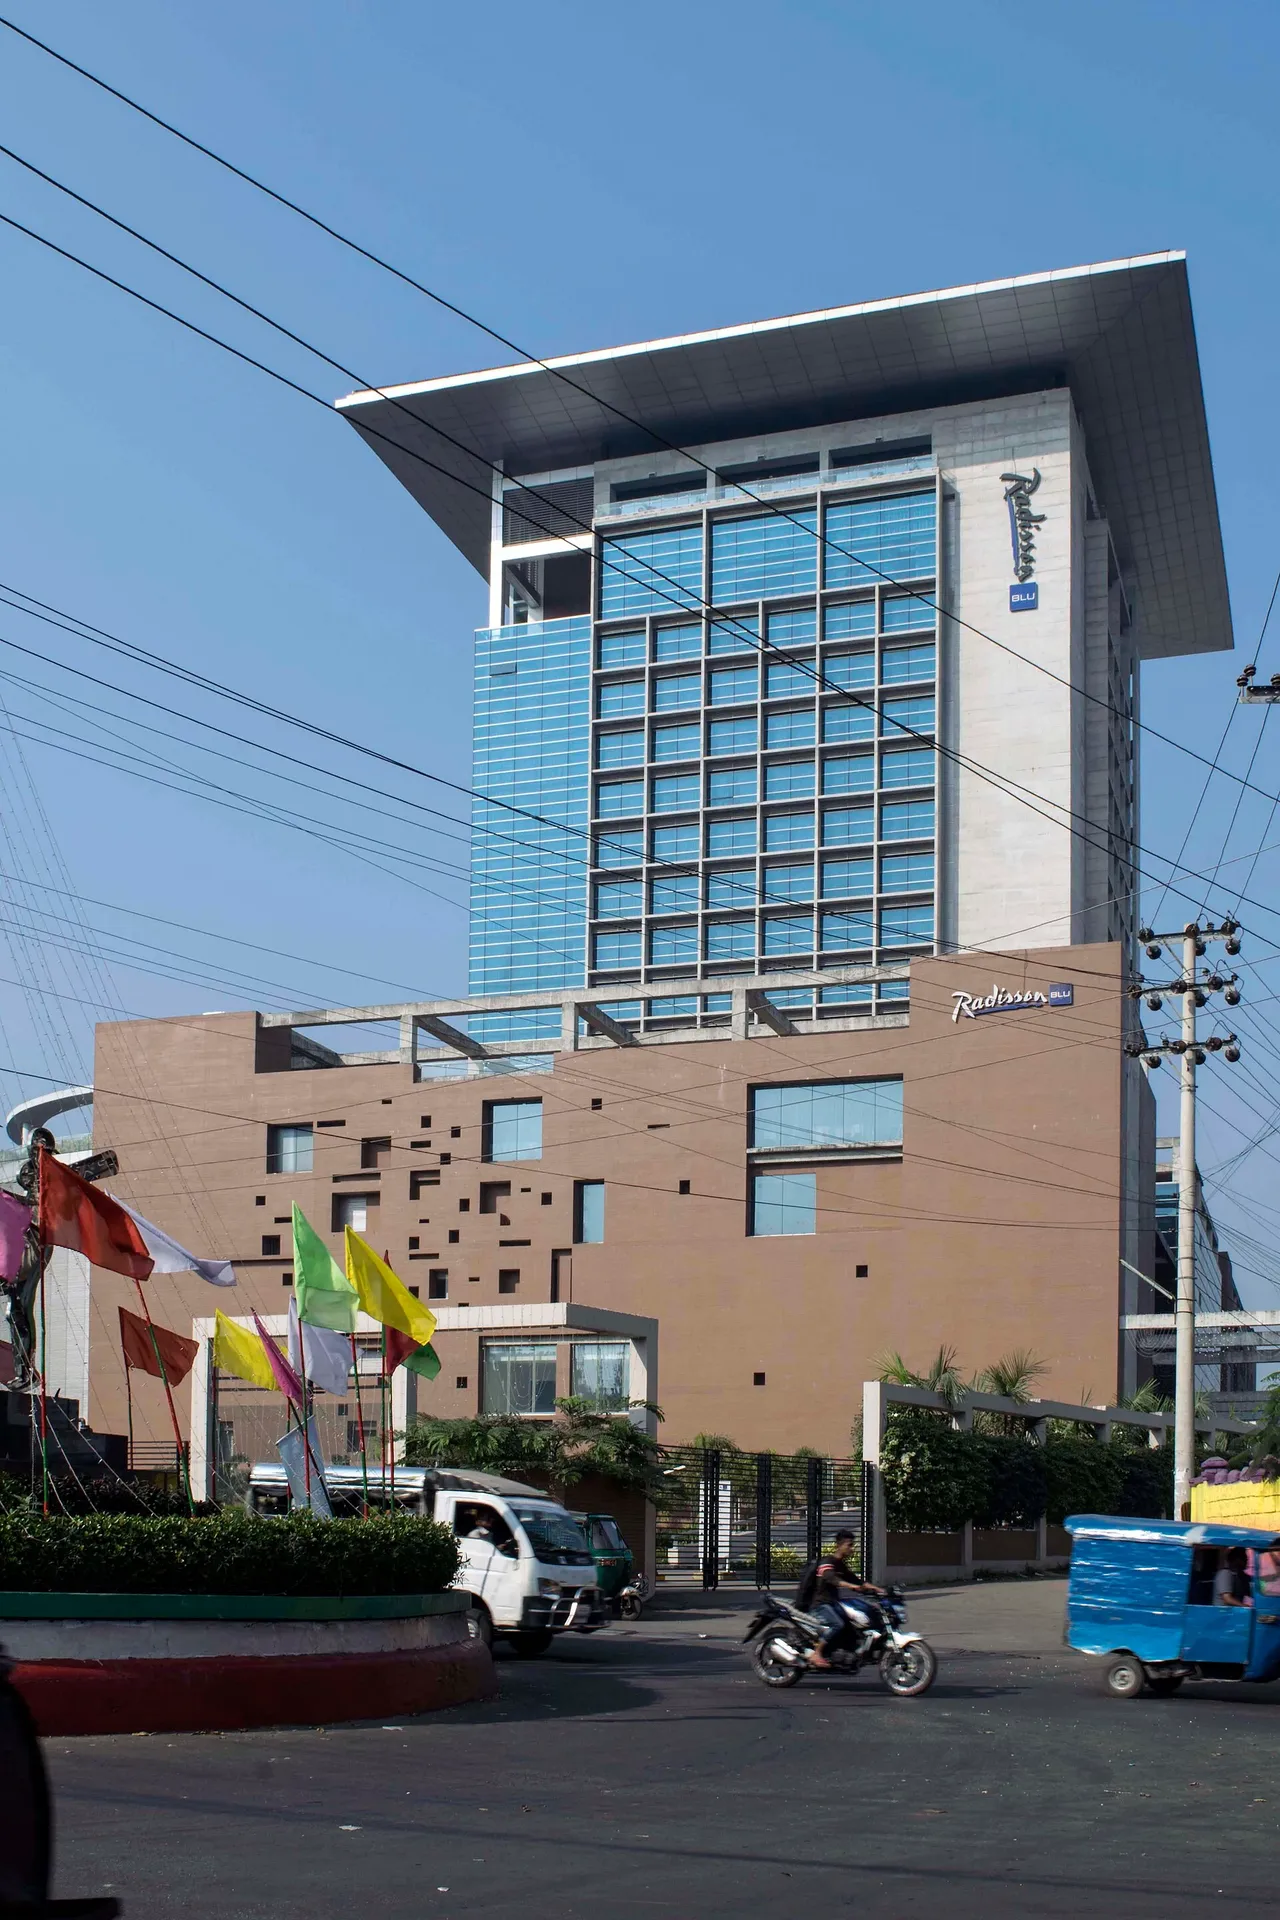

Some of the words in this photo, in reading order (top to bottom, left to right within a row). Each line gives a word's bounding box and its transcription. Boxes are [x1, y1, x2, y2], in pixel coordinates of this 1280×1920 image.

[1000, 467, 1047, 583] Radisson
[1011, 592, 1036, 603] BLU
[951, 984, 1049, 1023] Radisson
[1050, 990, 1071, 999] BLU
